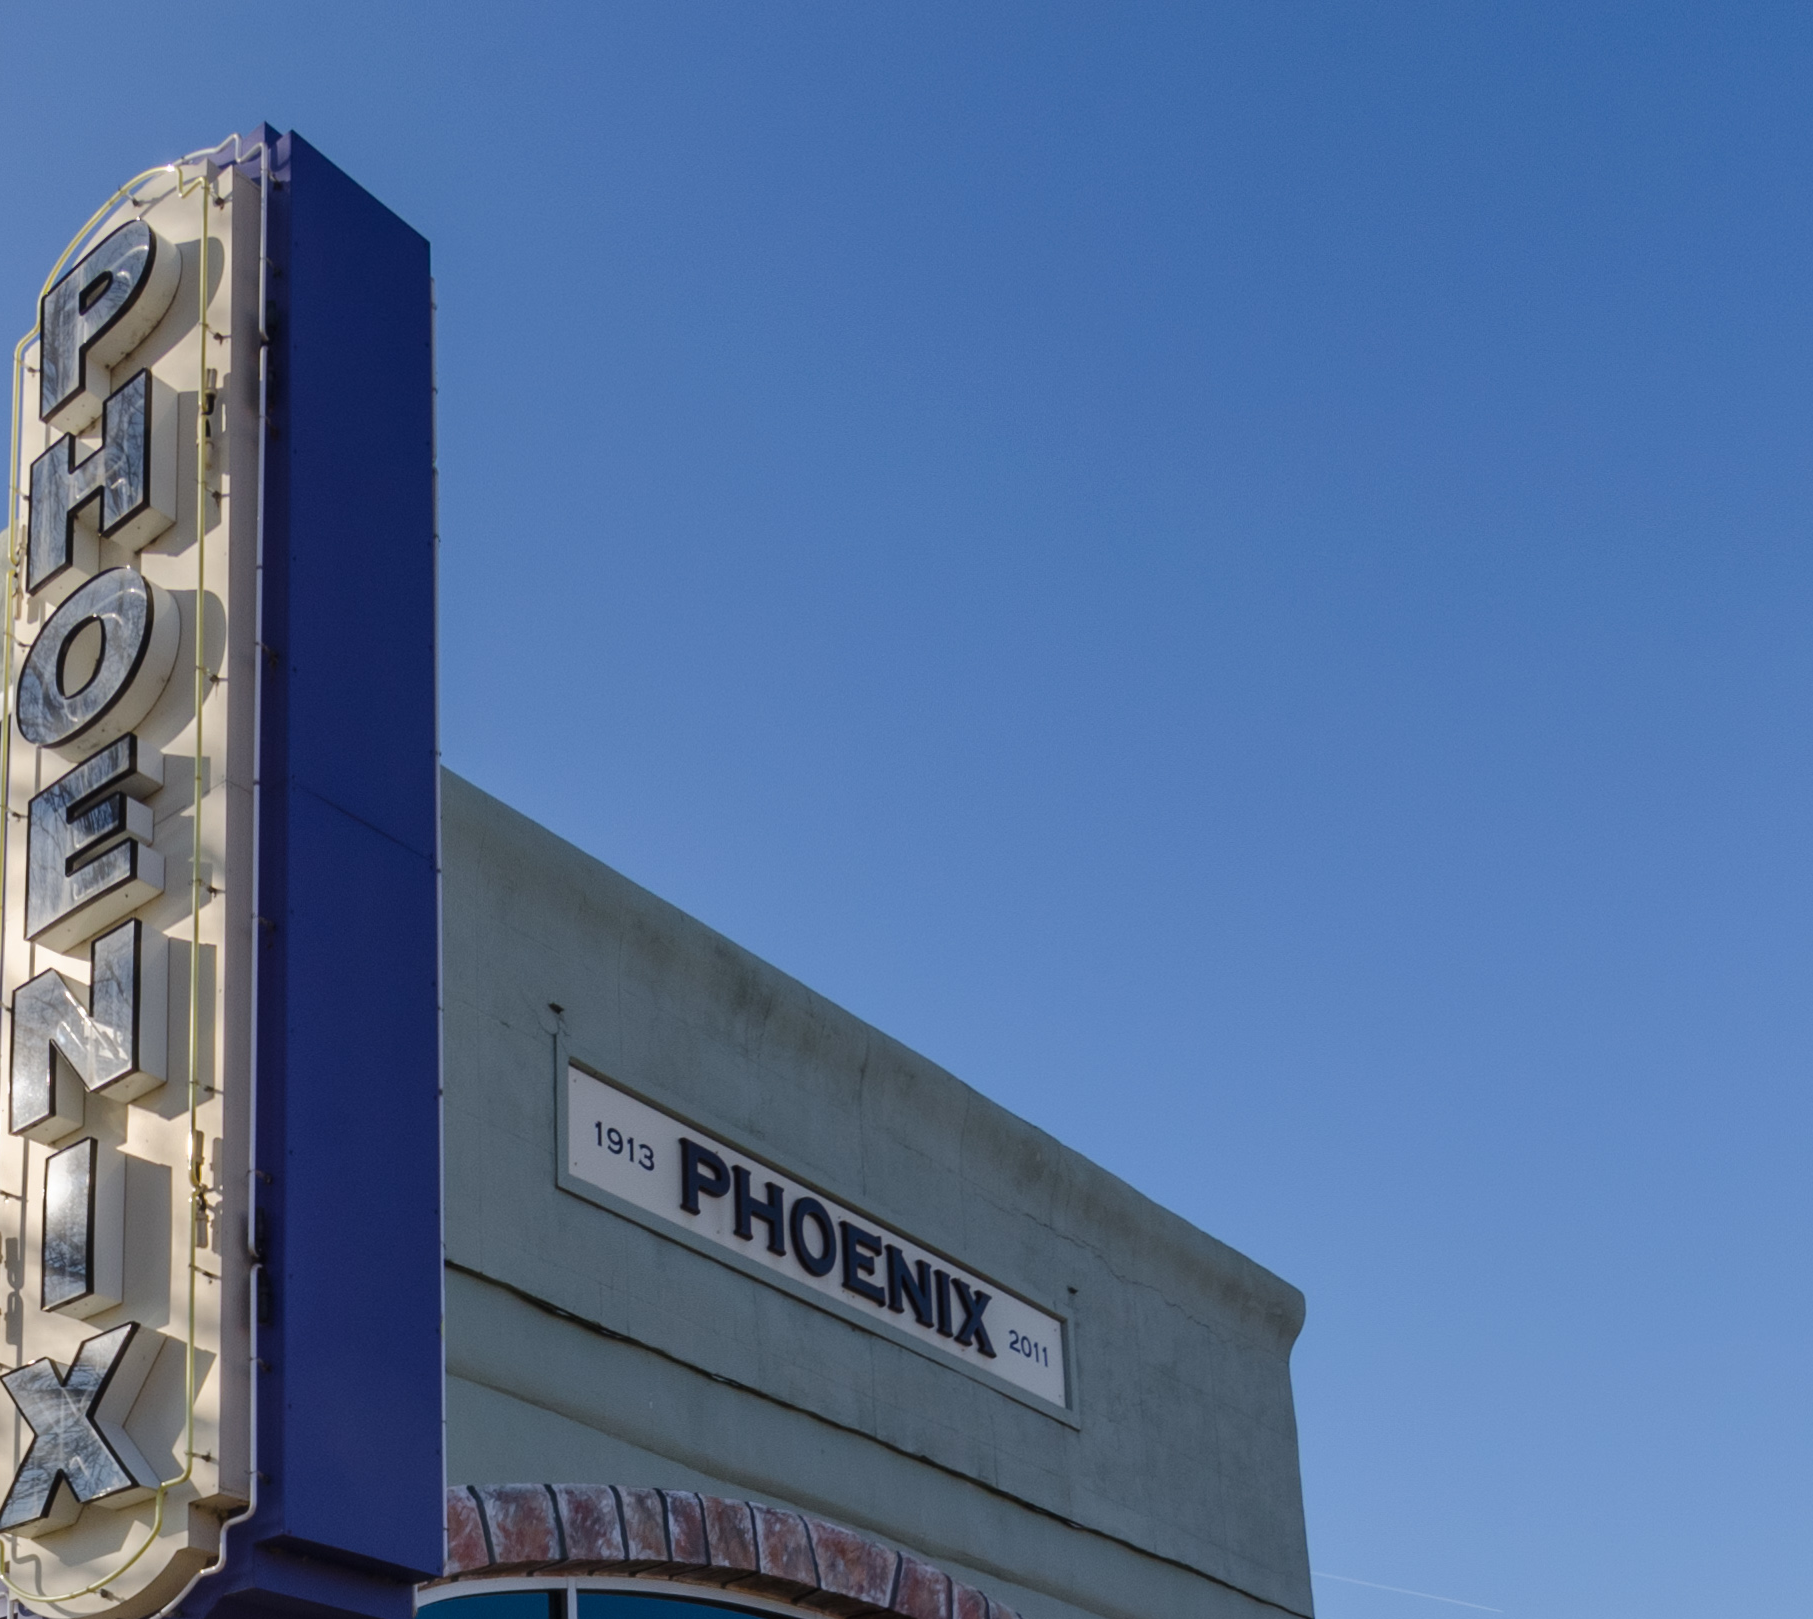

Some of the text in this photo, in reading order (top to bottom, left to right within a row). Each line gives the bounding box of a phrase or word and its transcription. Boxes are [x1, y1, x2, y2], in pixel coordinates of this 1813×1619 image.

[594, 1120, 655, 1171] 1913
[678, 1136, 998, 1359] PHOENIX
[1008, 1329, 1049, 1368] 2011
